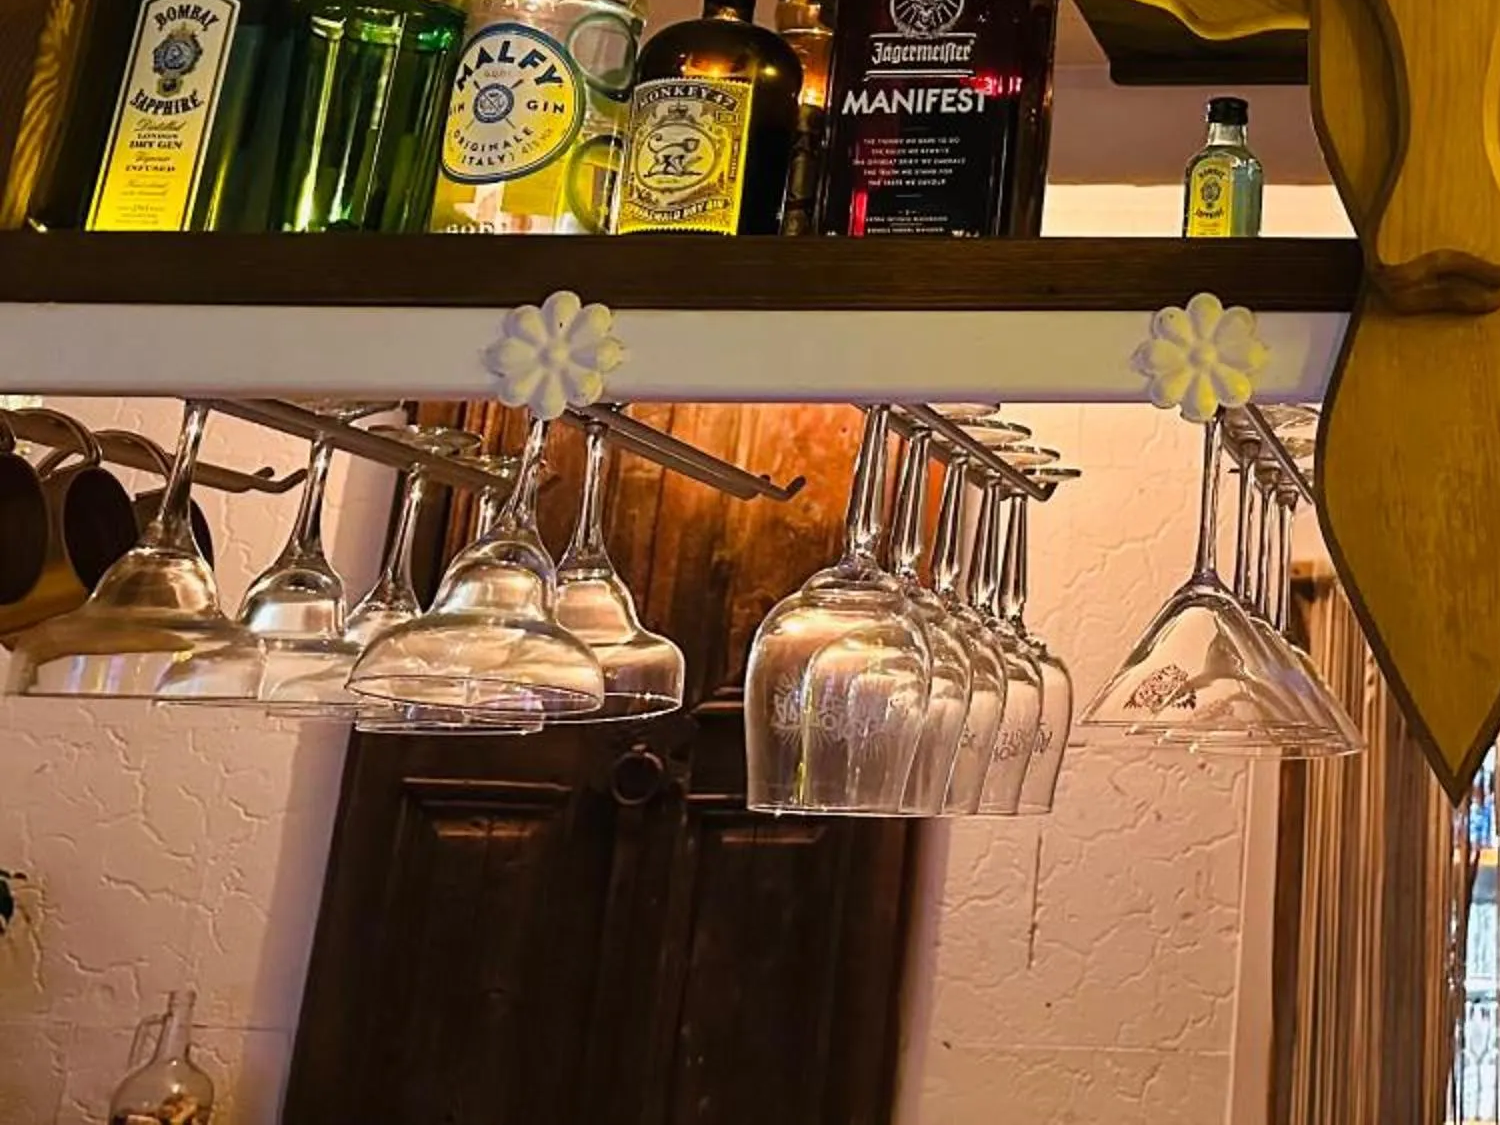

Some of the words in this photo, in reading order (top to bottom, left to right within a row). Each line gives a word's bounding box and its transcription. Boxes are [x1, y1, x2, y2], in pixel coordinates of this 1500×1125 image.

[153, 3, 220, 33] BOMBAY
[456, 40, 564, 92] MALFY
[129, 88, 203, 116] SAPPHIRE
[526, 99, 565, 114] GIN
[841, 87, 988, 116] MANIFEST
[453, 127, 534, 153] ORIGINALE
